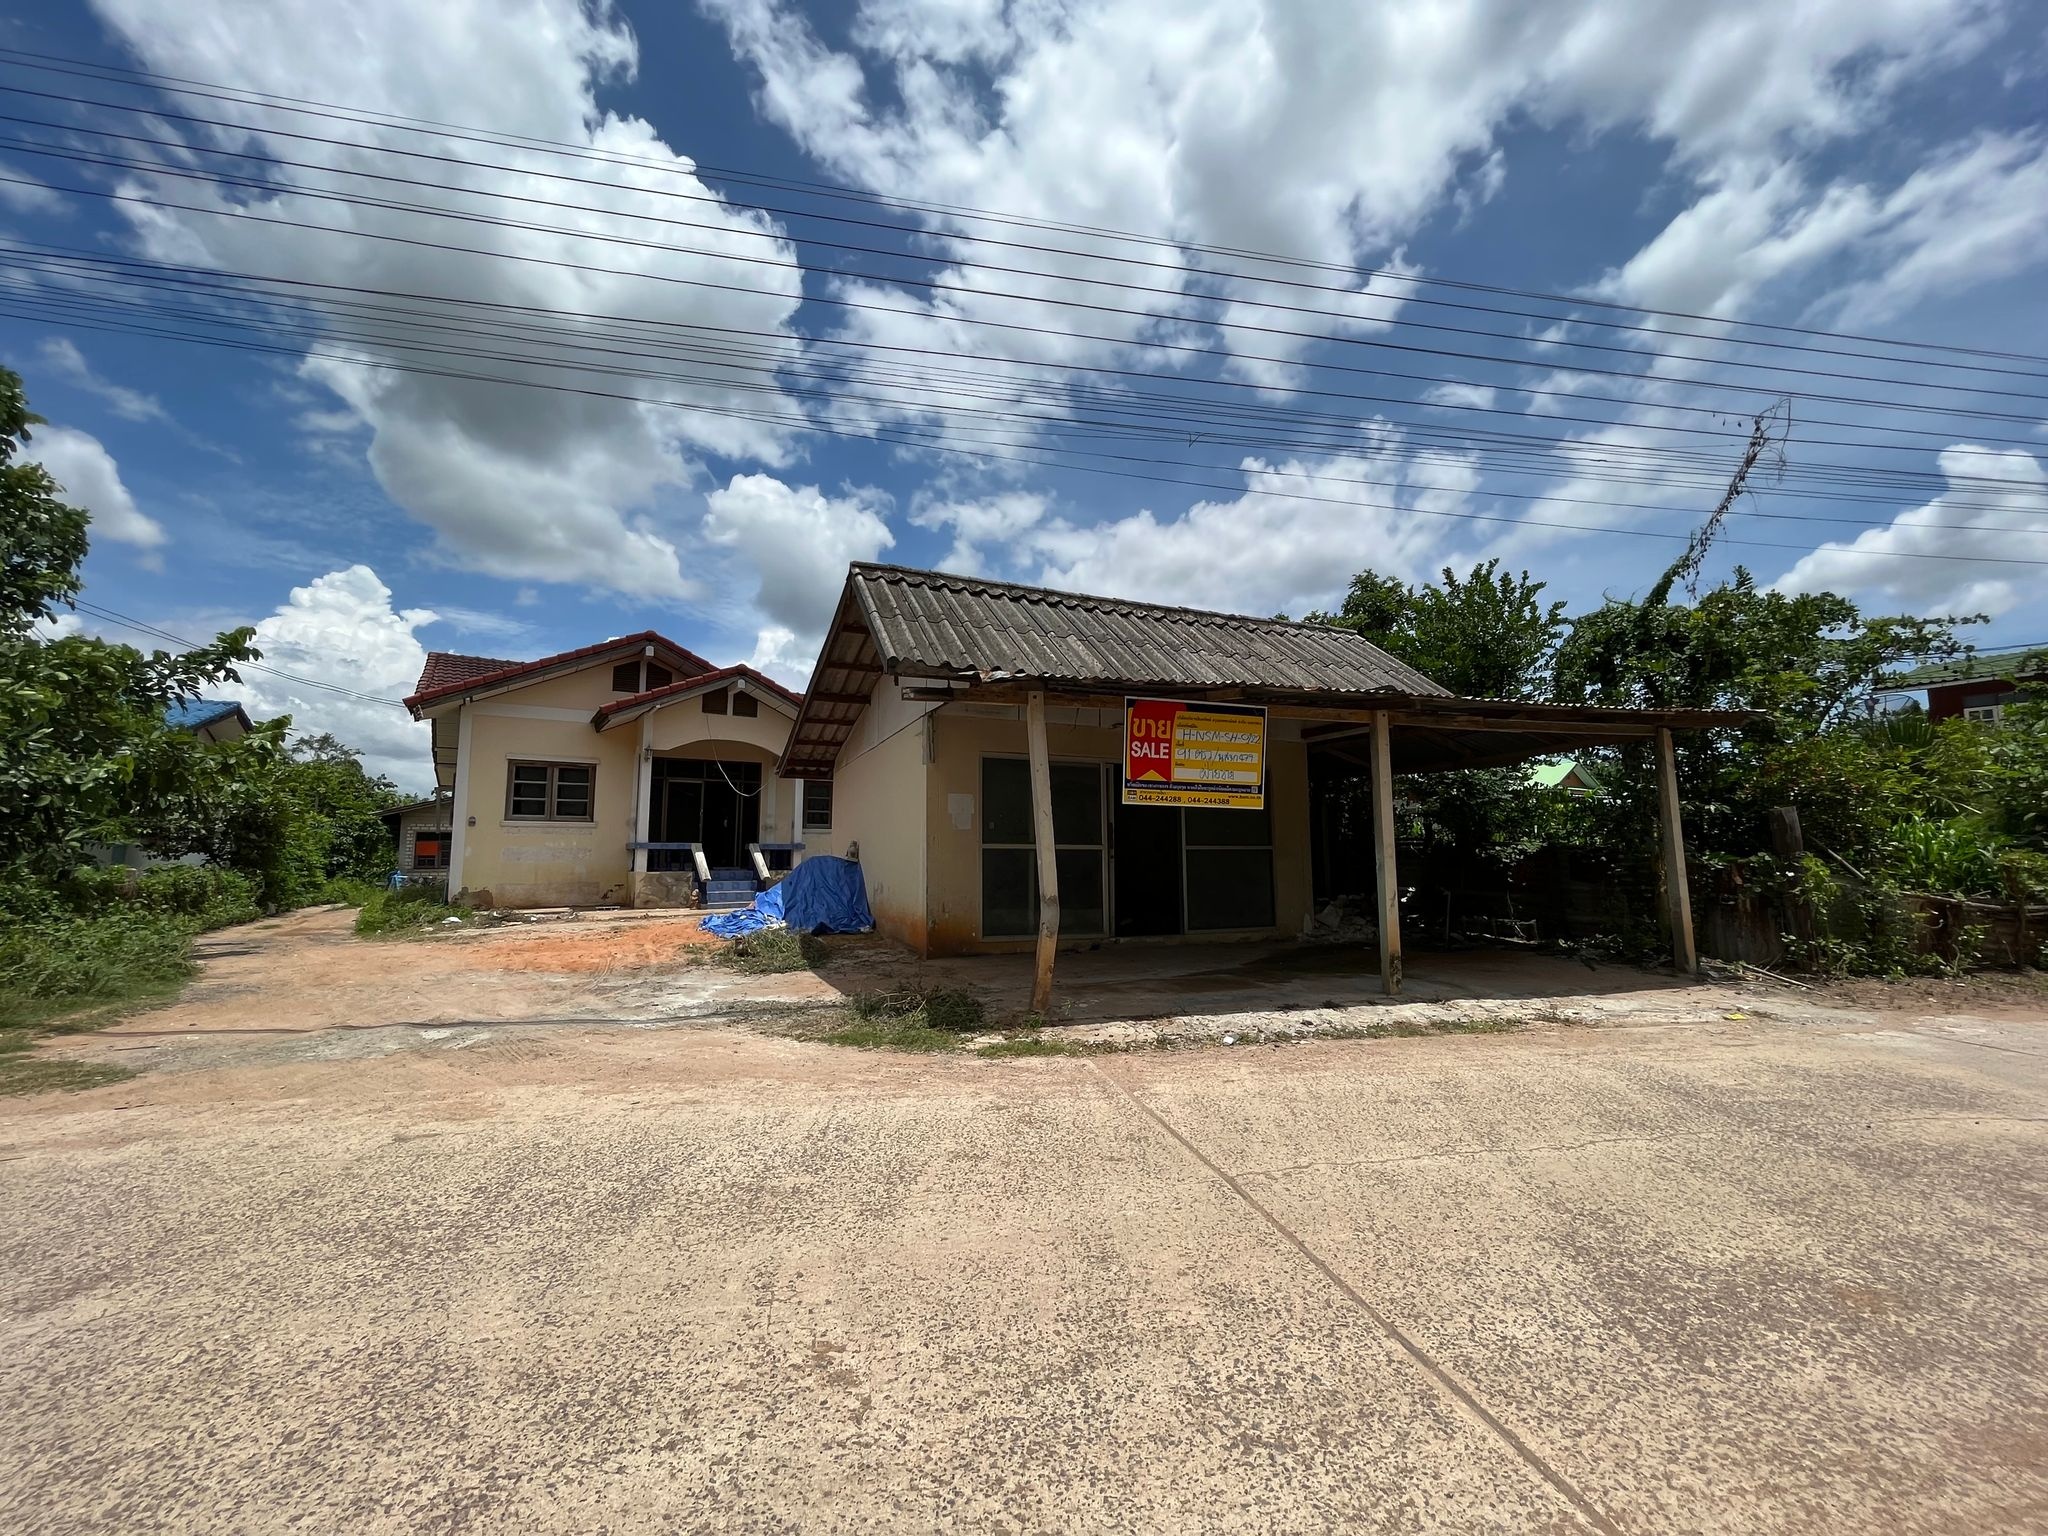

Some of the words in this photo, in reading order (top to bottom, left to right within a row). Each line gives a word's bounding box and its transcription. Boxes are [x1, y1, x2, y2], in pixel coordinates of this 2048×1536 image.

[1132, 718, 1171, 739] ขาย
[1131, 741, 1170, 759] SALE
[1138, 795, 1182, 803] 044-244288
